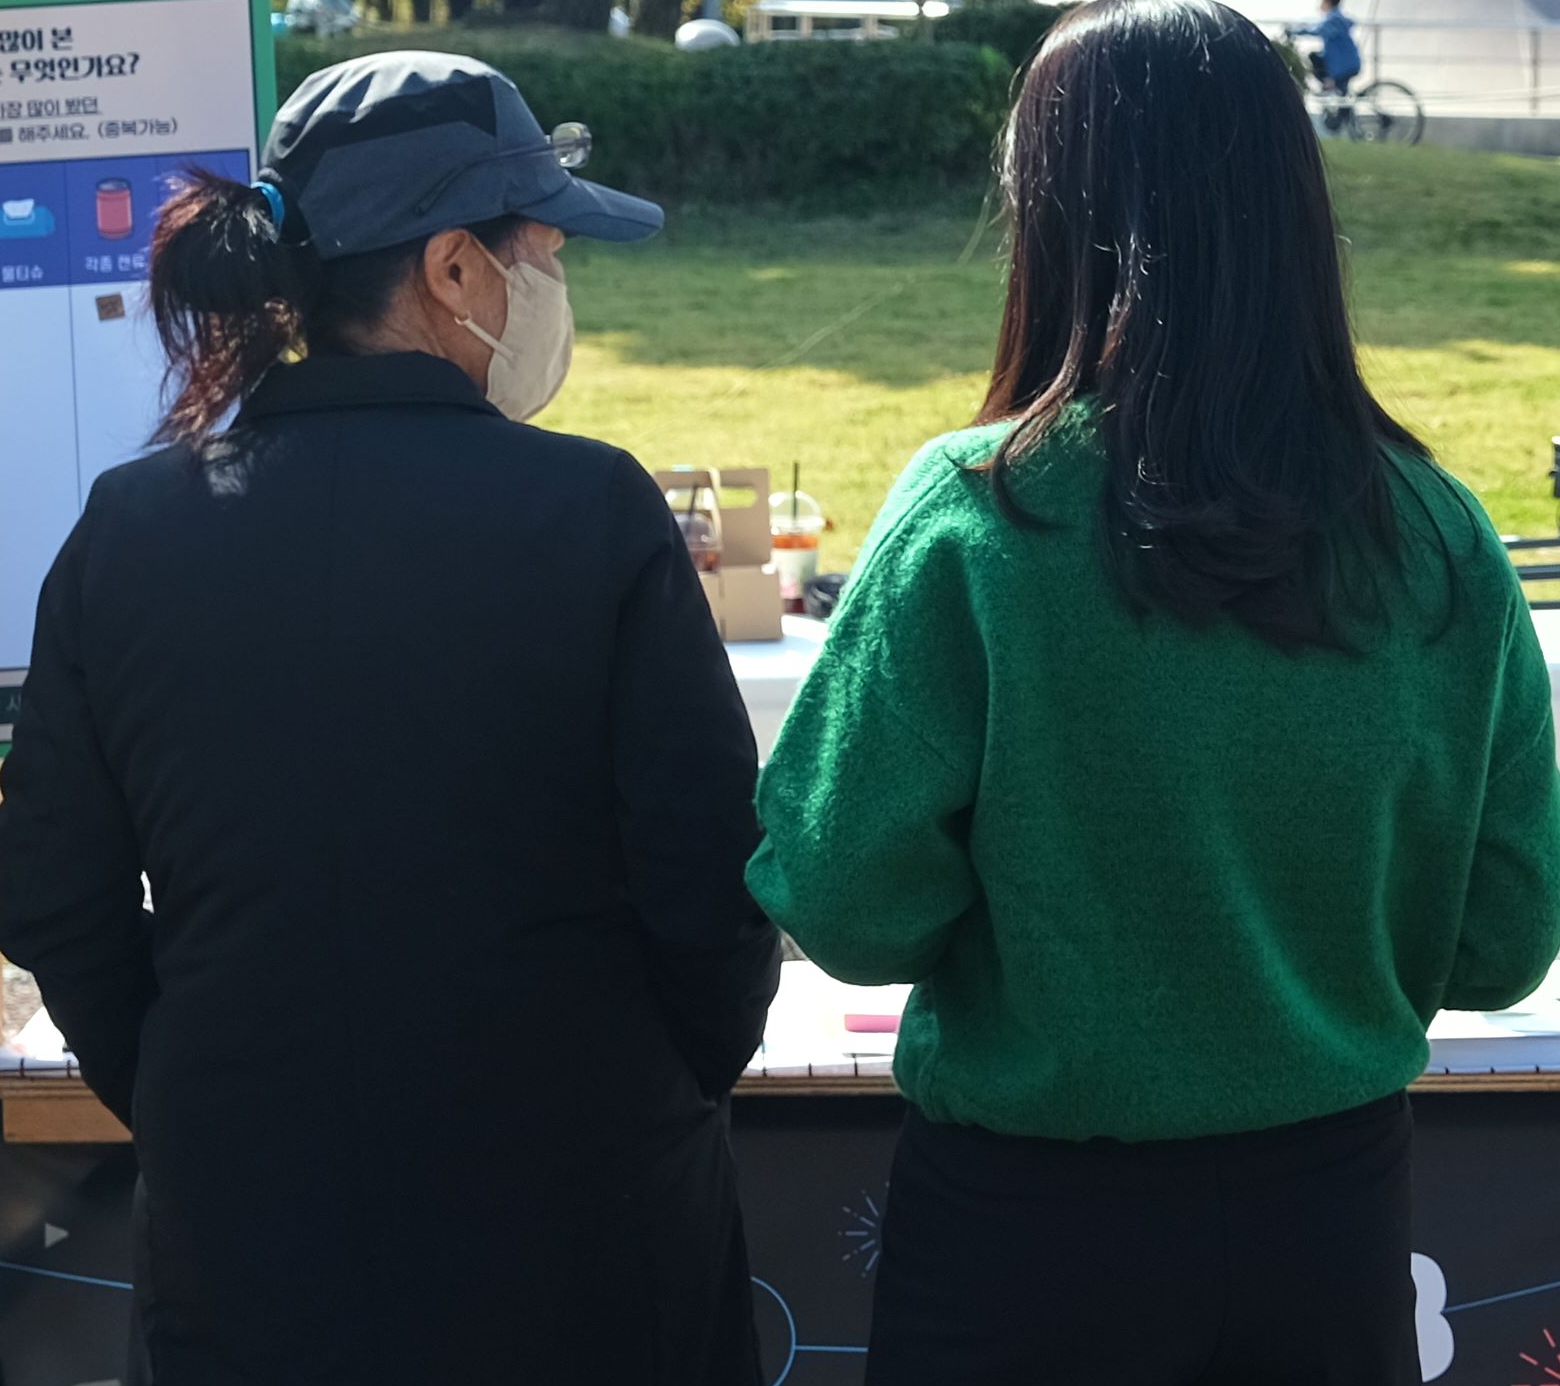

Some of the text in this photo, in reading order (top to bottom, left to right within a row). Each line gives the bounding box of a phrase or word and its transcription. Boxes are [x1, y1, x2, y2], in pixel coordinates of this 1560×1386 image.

[51, 26, 74, 52] 본
[9, 52, 141, 83] 무엇인가요?
[26, 98, 60, 119] 많이
[96, 116, 179, 140] (중복가능)
